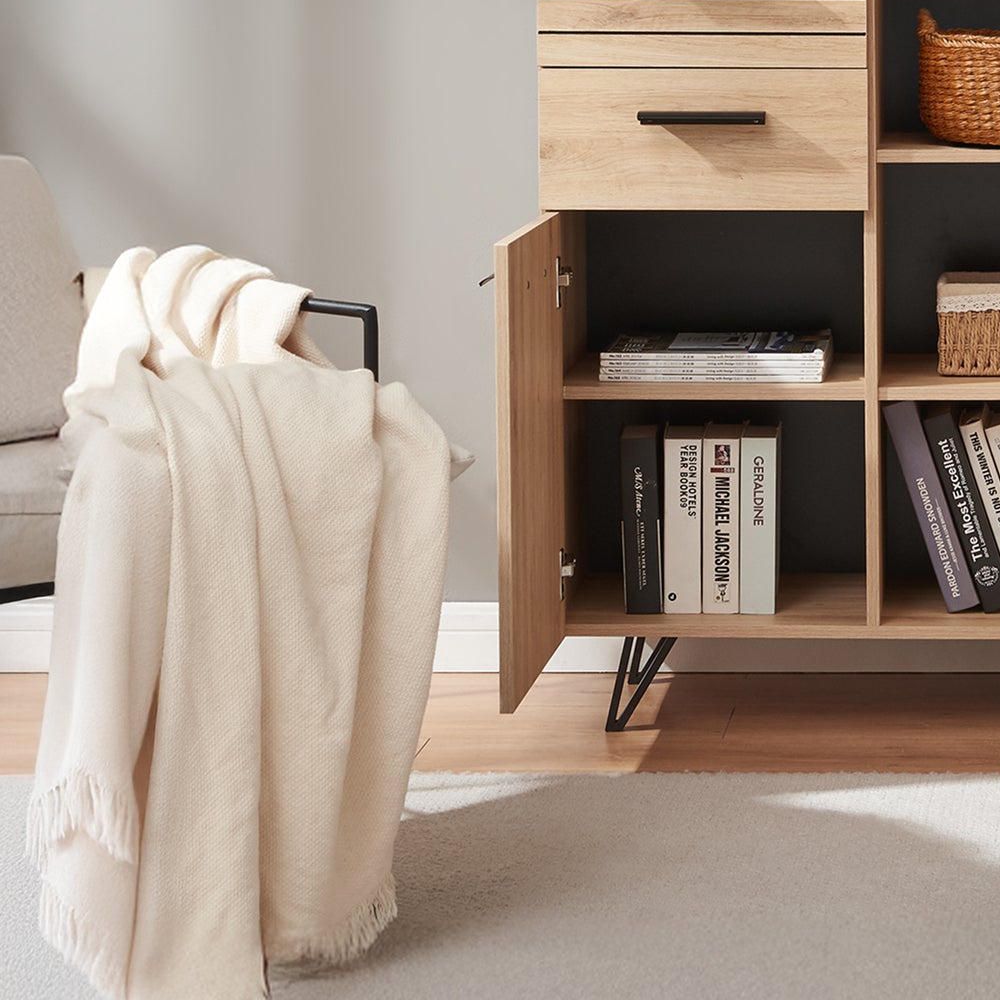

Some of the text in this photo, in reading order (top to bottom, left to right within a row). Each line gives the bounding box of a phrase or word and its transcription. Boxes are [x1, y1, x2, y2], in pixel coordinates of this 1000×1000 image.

[679, 444, 689, 469] YEAR
[937, 438, 965, 500] Excellent
[969, 431, 983, 452] THIS
[976, 452, 994, 486] WINTER
[987, 486, 998, 496] IS
[687, 444, 698, 517] DESIGN HOTELS
[715, 476, 730, 526] MICHAEL
[753, 455, 765, 527] GERALDINE
[915, 477, 937, 522] SNOWDEN
[957, 500, 975, 535] Most
[714, 529, 730, 583] JACKSON
[930, 522, 949, 561] EDWARD
[970, 536, 983, 563] The
[942, 561, 961, 598] PARDON
